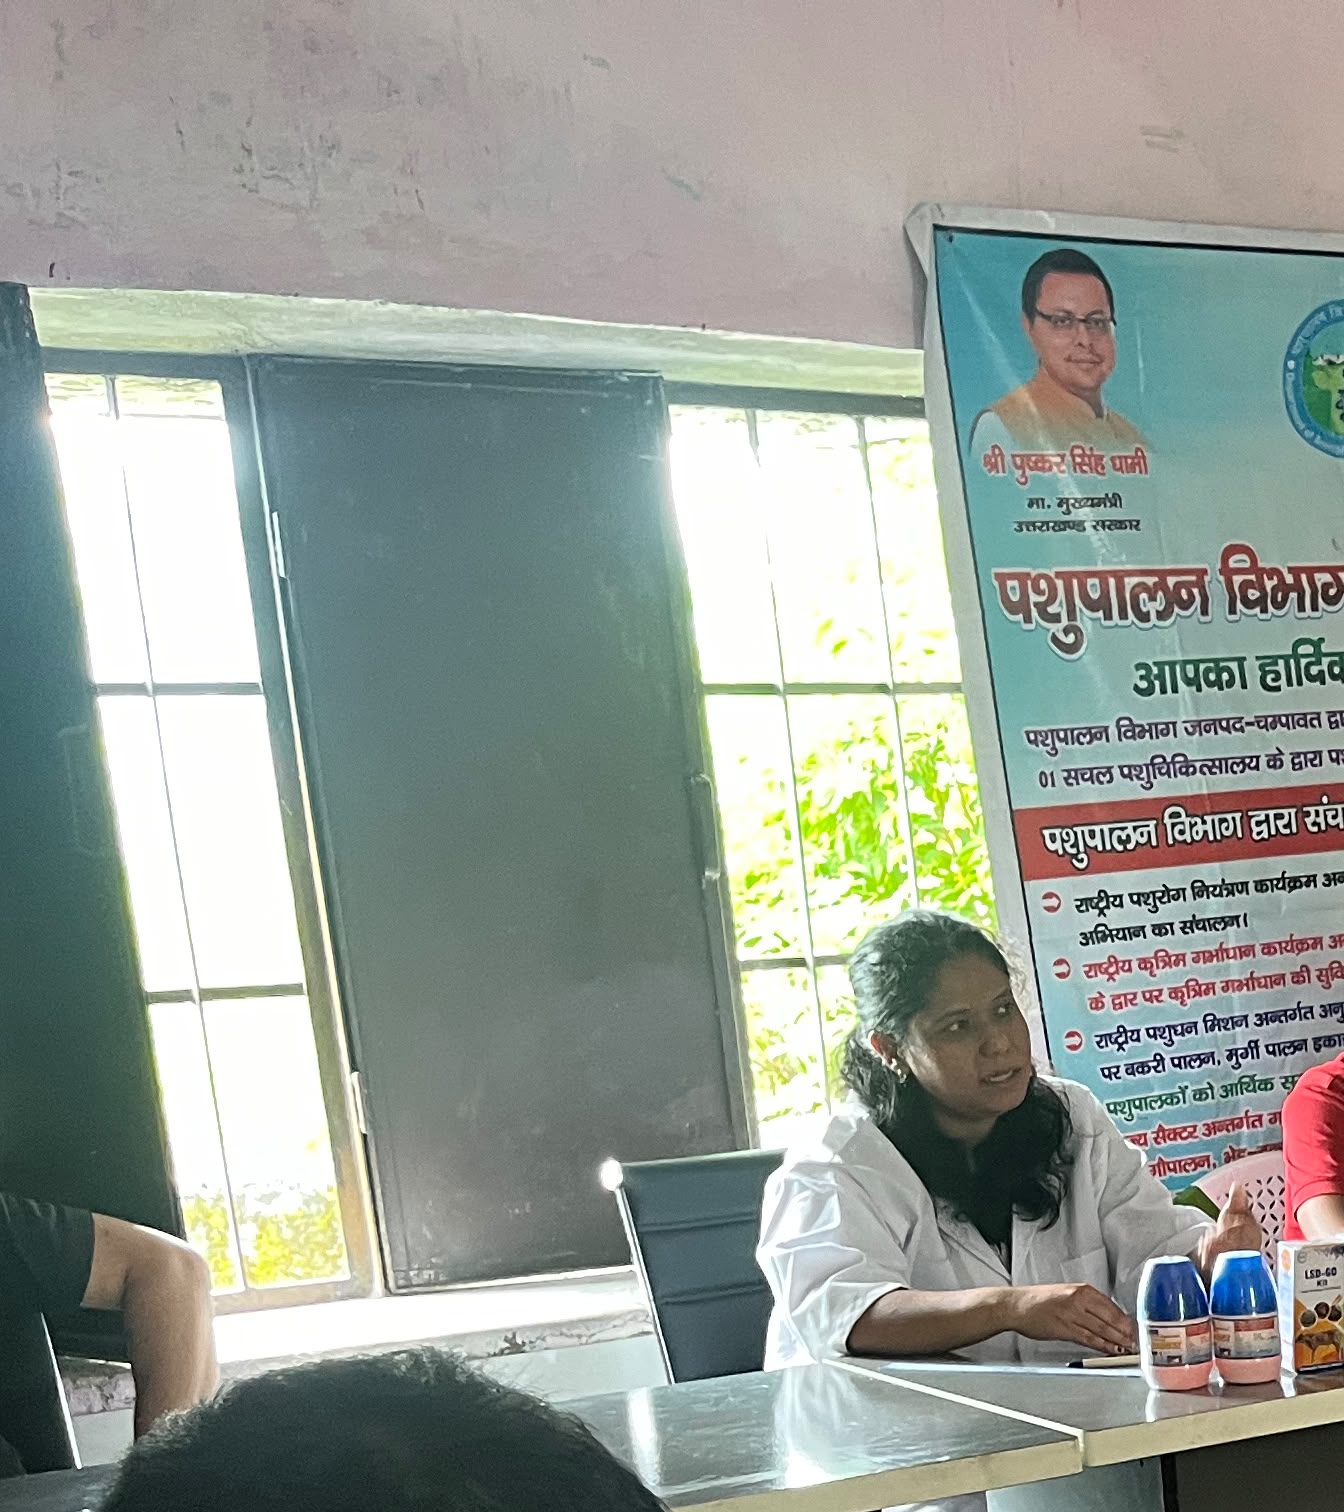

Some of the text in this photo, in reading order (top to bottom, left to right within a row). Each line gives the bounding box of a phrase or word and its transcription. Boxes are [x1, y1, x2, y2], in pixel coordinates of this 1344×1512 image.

[984, 444, 1006, 473] श्री
[1011, 453, 1066, 485] पुष्कर
[1070, 445, 1106, 476] सिंह
[1057, 493, 1122, 515] मुख्यमंत्री
[994, 568, 1208, 656] पशुपालन
[1133, 656, 1248, 697] आपका
[1025, 726, 1109, 756] पशुपालन
[1116, 717, 1177, 741] विभाग
[1039, 771, 1054, 788] 01
[1063, 766, 1113, 786] सचल
[1119, 754, 1260, 790] पशुचिकित्सालय
[1266, 747, 1284, 770] के
[1291, 750, 1323, 771] द्वारा
[1043, 820, 1157, 869] पशुपालन
[1164, 806, 1242, 846] विभाग
[1249, 807, 1297, 839] द्वारा
[1075, 890, 1124, 917] राष्ट्रीय
[1129, 884, 1186, 914] पशुरोग
[1192, 878, 1250, 901] नियंत्रण
[1254, 871, 1317, 894] कार्यक्रम
[1079, 923, 1147, 946] अभियान
[1151, 922, 1174, 937] का
[1083, 955, 1132, 982] राष्ट्रीय
[1136, 949, 1186, 977] कृत्रिम
[1260, 934, 1323, 956] कार्यक्रम
[1088, 991, 1105, 1011] के
[1110, 992, 1137, 1011] द्वार
[1142, 988, 1164, 1004] पर
[1168, 978, 1216, 1006] कृत्रिम
[1290, 965, 1311, 985] की
[1094, 1024, 1141, 1051] राष्ट्रीय
[1202, 1013, 1249, 1034] मिशन
[1254, 1001, 1314, 1028] अन्तर्गत
[1100, 1065, 1121, 1081] पर
[1226, 1040, 1260, 1070] मुर्गी
[1264, 1041, 1308, 1058] पालन
[1106, 1086, 1188, 1120] पशुपालकों
[1192, 1082, 1215, 1102] को
[1220, 1074, 1274, 1099] आर्थिक
[1202, 1110, 1263, 1137] अन्तर्गत
